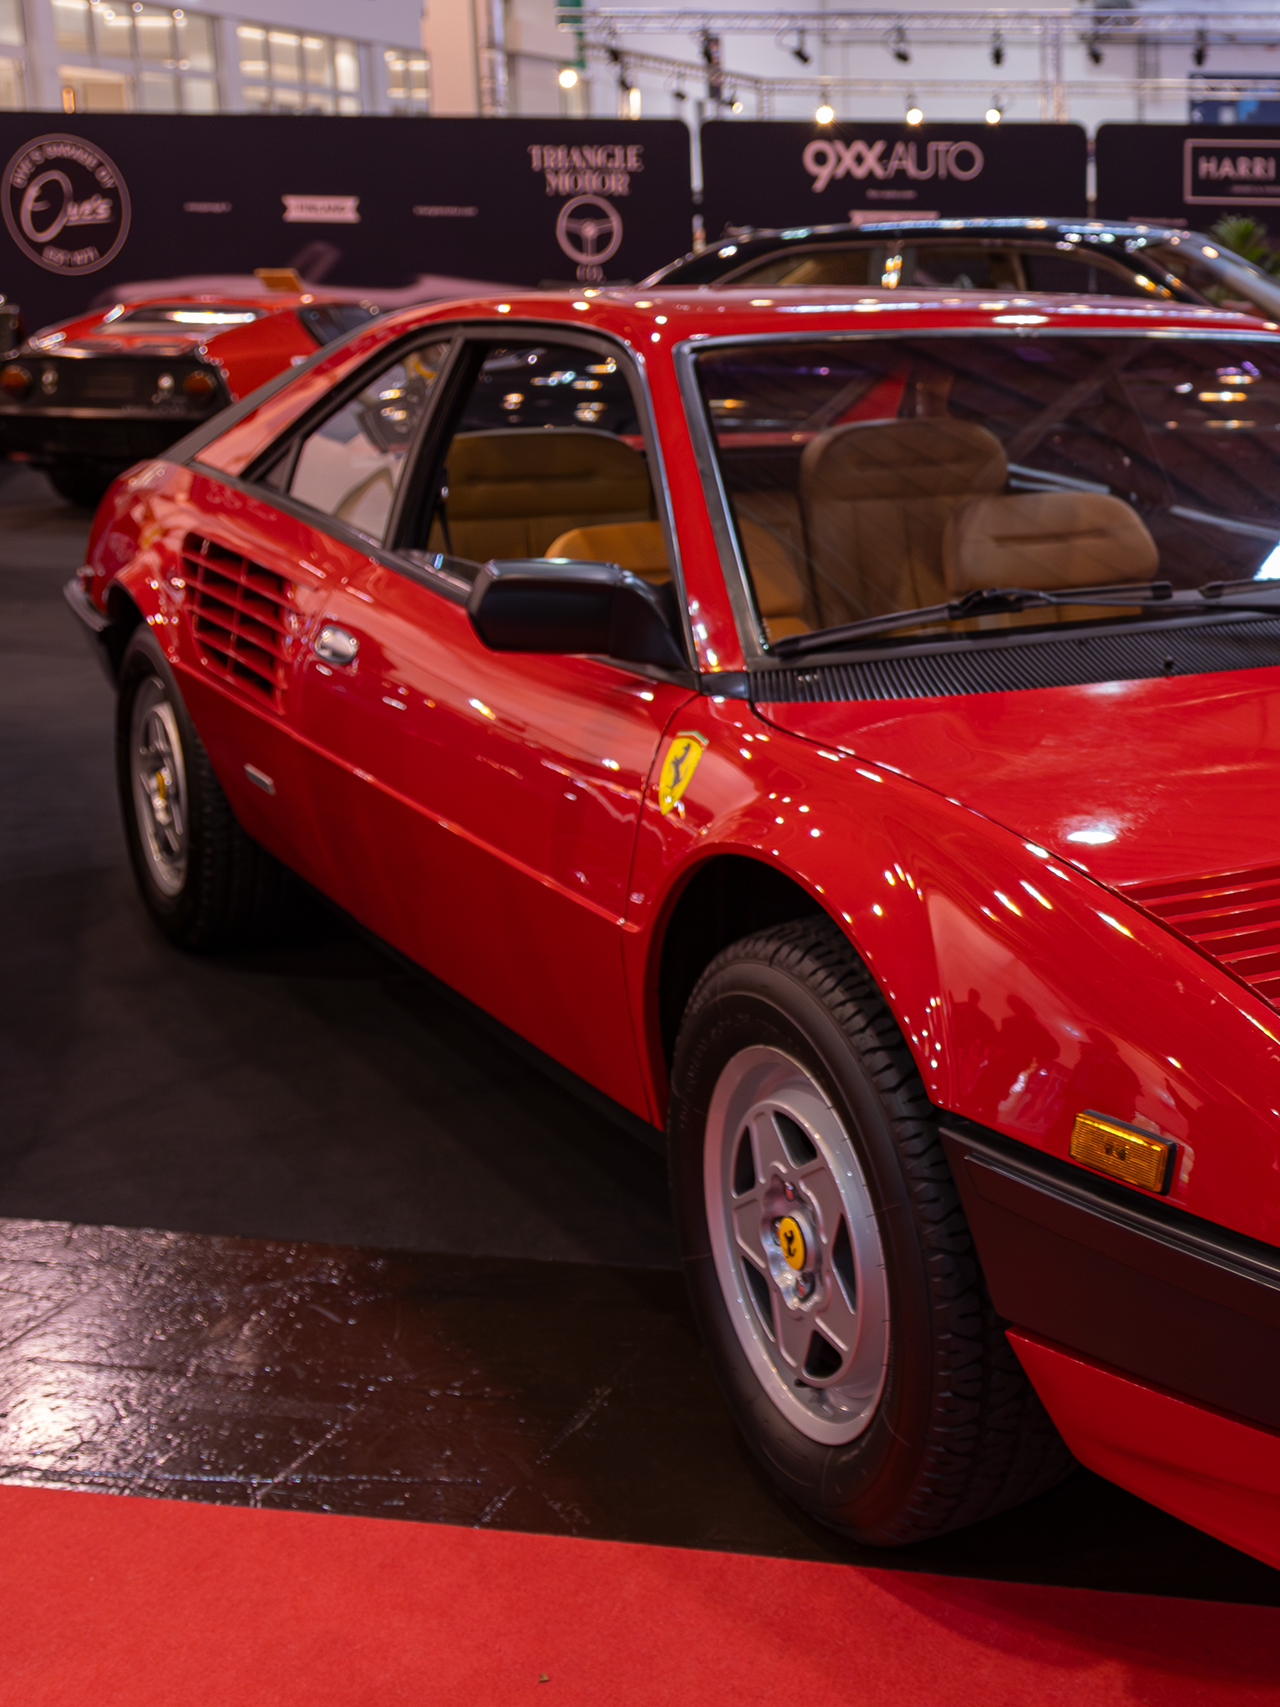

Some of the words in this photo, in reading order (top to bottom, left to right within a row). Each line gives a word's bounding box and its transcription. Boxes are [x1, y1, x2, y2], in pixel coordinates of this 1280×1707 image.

[527, 144, 645, 172] TRIANGLE
[1198, 156, 1277, 181] HARRI
[545, 169, 632, 196] MOTOR
